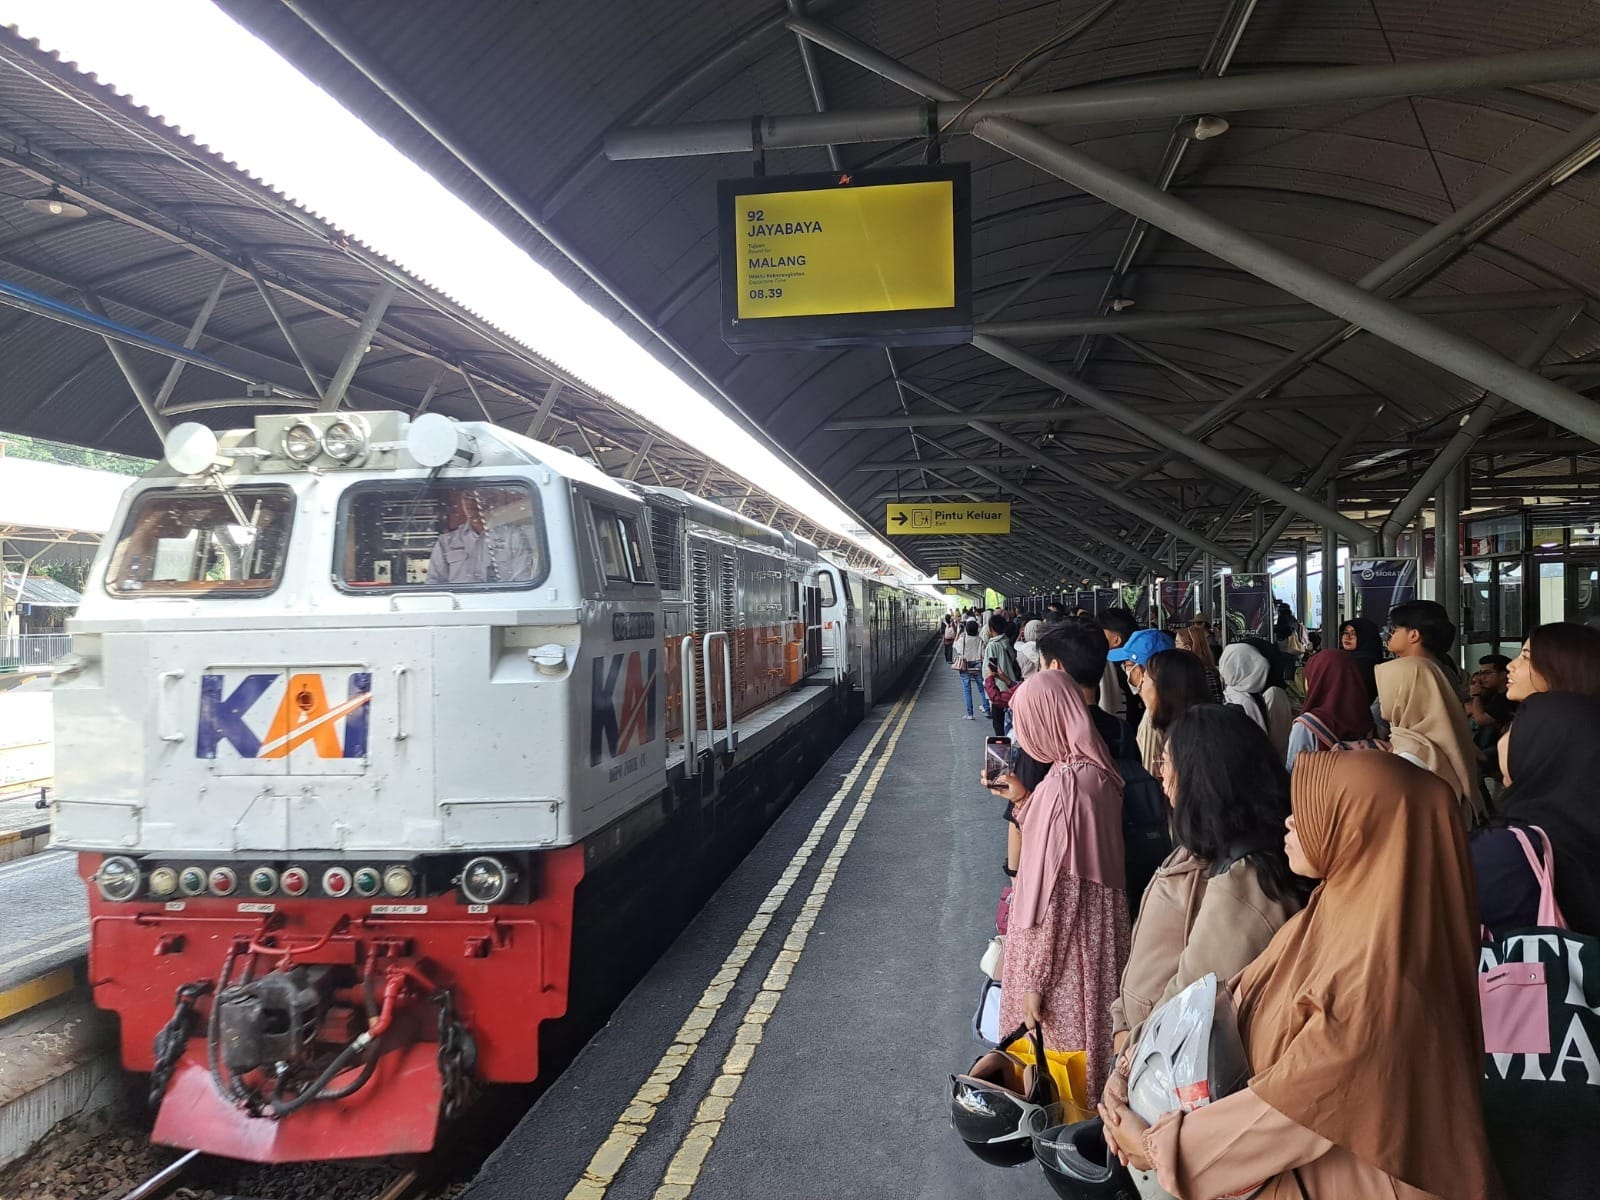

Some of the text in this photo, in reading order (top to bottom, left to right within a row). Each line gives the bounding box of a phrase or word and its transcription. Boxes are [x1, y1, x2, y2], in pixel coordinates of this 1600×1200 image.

[747, 210, 764, 222] 92
[747, 221, 823, 237] JAYABAYA
[749, 255, 806, 269] MALANG
[749, 288, 783, 299] 08.39
[935, 510, 1003, 520] Pintu Keluar
[196, 672, 372, 759] KAI
[590, 649, 656, 768] KAI
